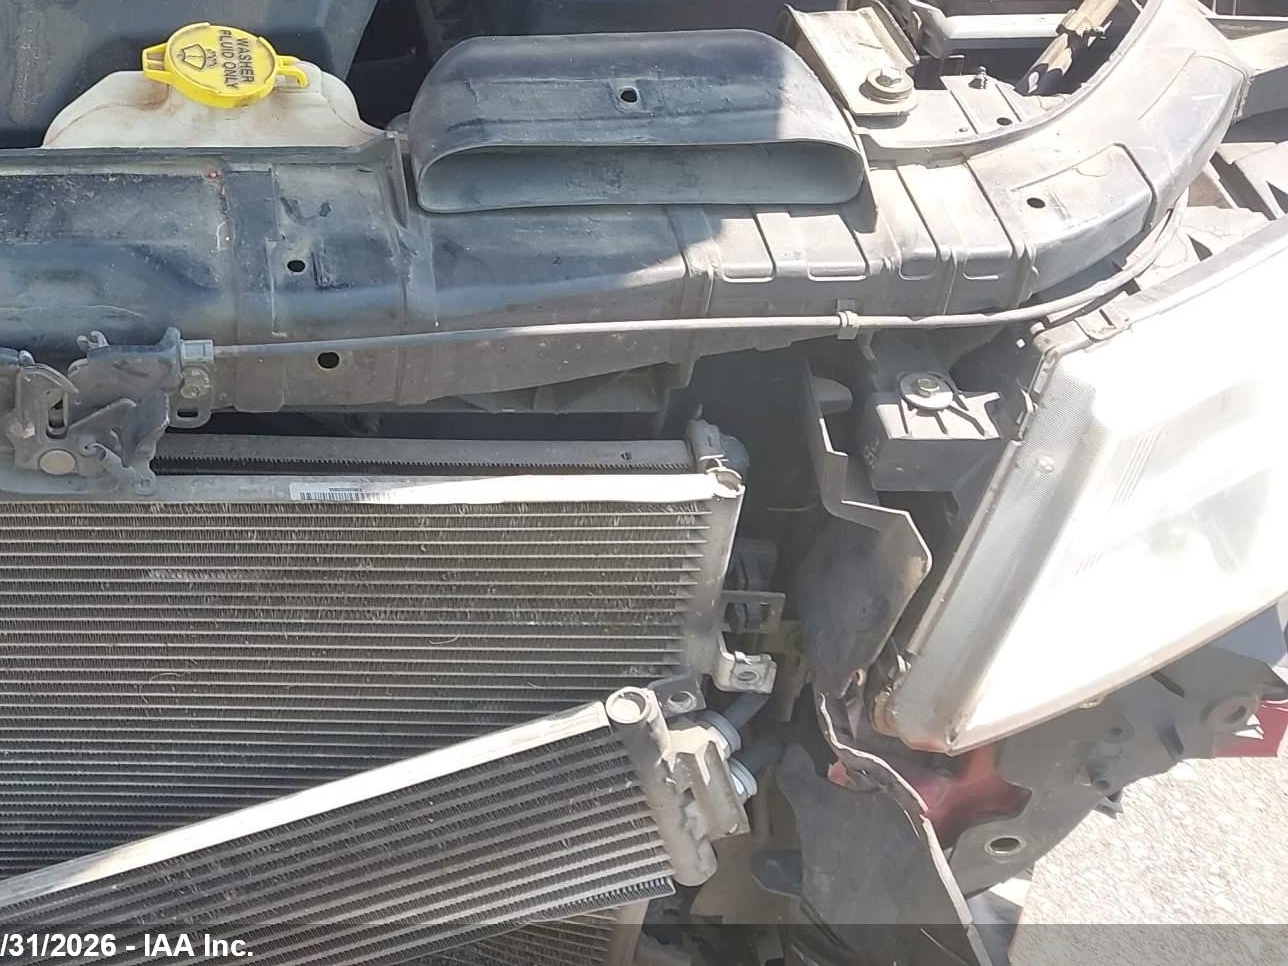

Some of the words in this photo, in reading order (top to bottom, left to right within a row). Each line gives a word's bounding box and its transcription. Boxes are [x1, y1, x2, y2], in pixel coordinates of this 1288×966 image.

[219, 30, 235, 59] FLUID
[223, 61, 239, 89] ONLY
[237, 38, 255, 83] WASHER
